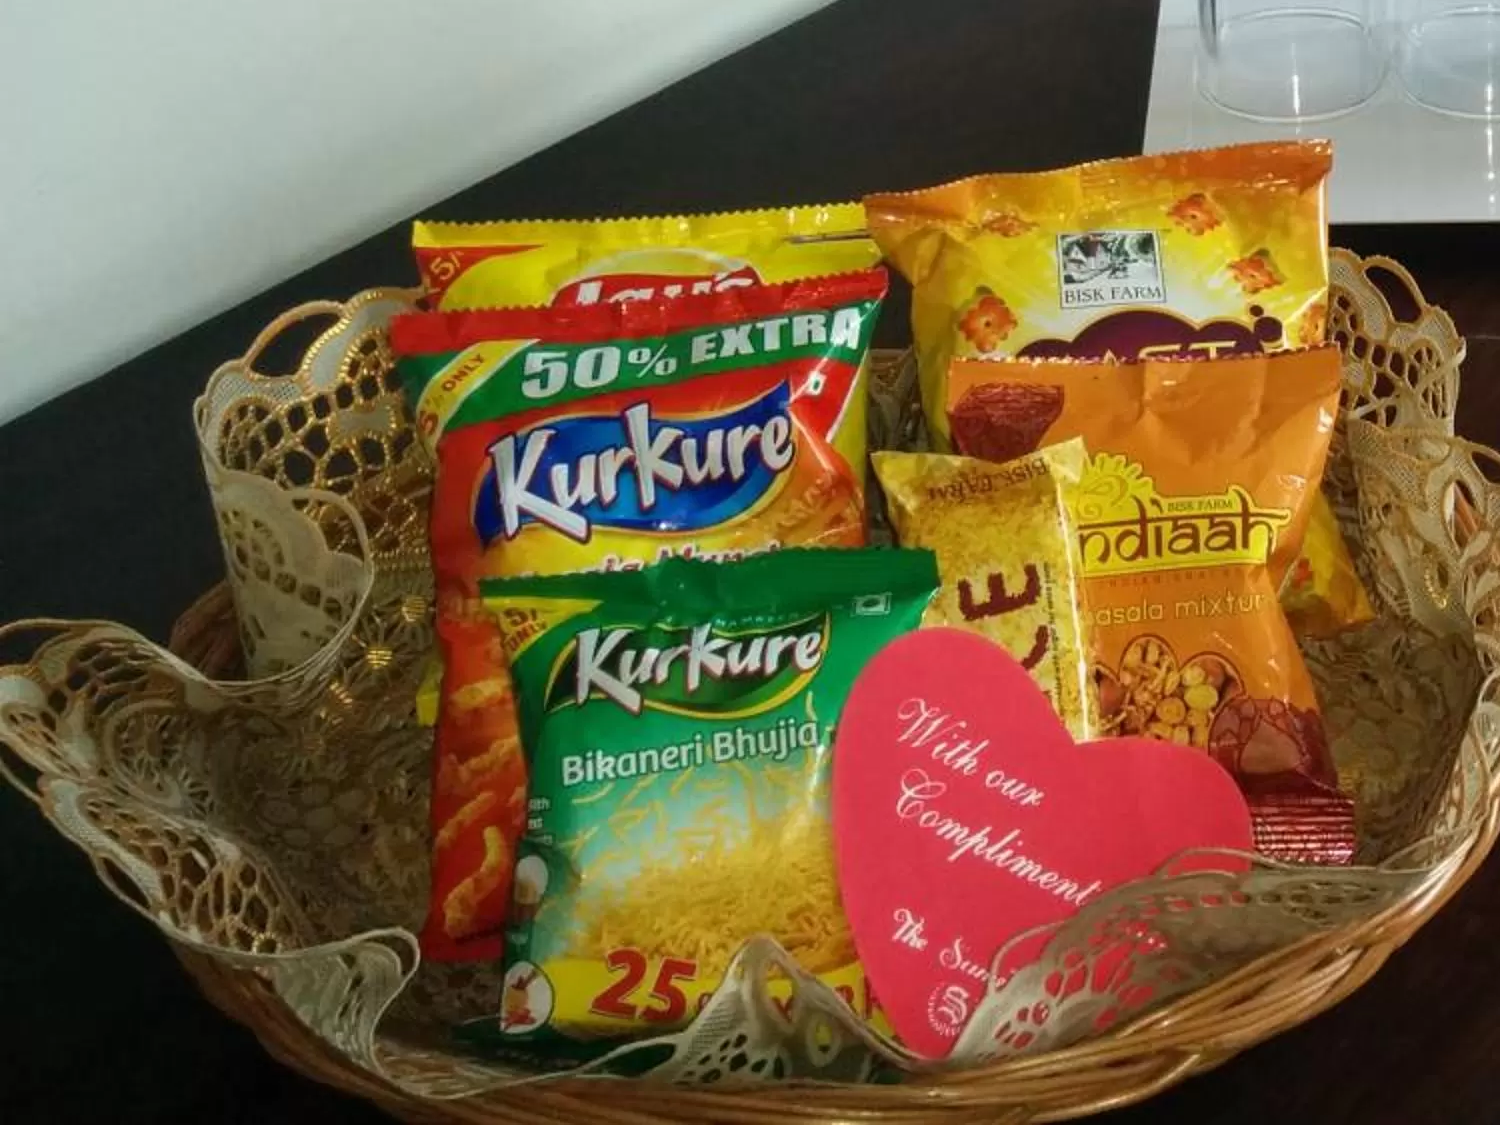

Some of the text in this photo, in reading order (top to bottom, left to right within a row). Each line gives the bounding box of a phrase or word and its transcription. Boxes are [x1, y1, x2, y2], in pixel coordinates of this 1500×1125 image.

[1065, 285, 1162, 304] BISK FARM
[442, 354, 484, 392] ONLY
[520, 307, 862, 400] 50% EXTRA
[488, 401, 796, 542] Kurkure
[1167, 501, 1194, 513] BISK
[1078, 484, 1289, 565] ndiaah
[1175, 588, 1265, 619] mixtur
[576, 623, 823, 714] Kurkure
[561, 718, 818, 786] Bikaneri Bhujia
[897, 698, 1046, 808] With our
[895, 768, 1101, 906] Compliment
[892, 907, 929, 952] The
[588, 947, 698, 1024] 25
